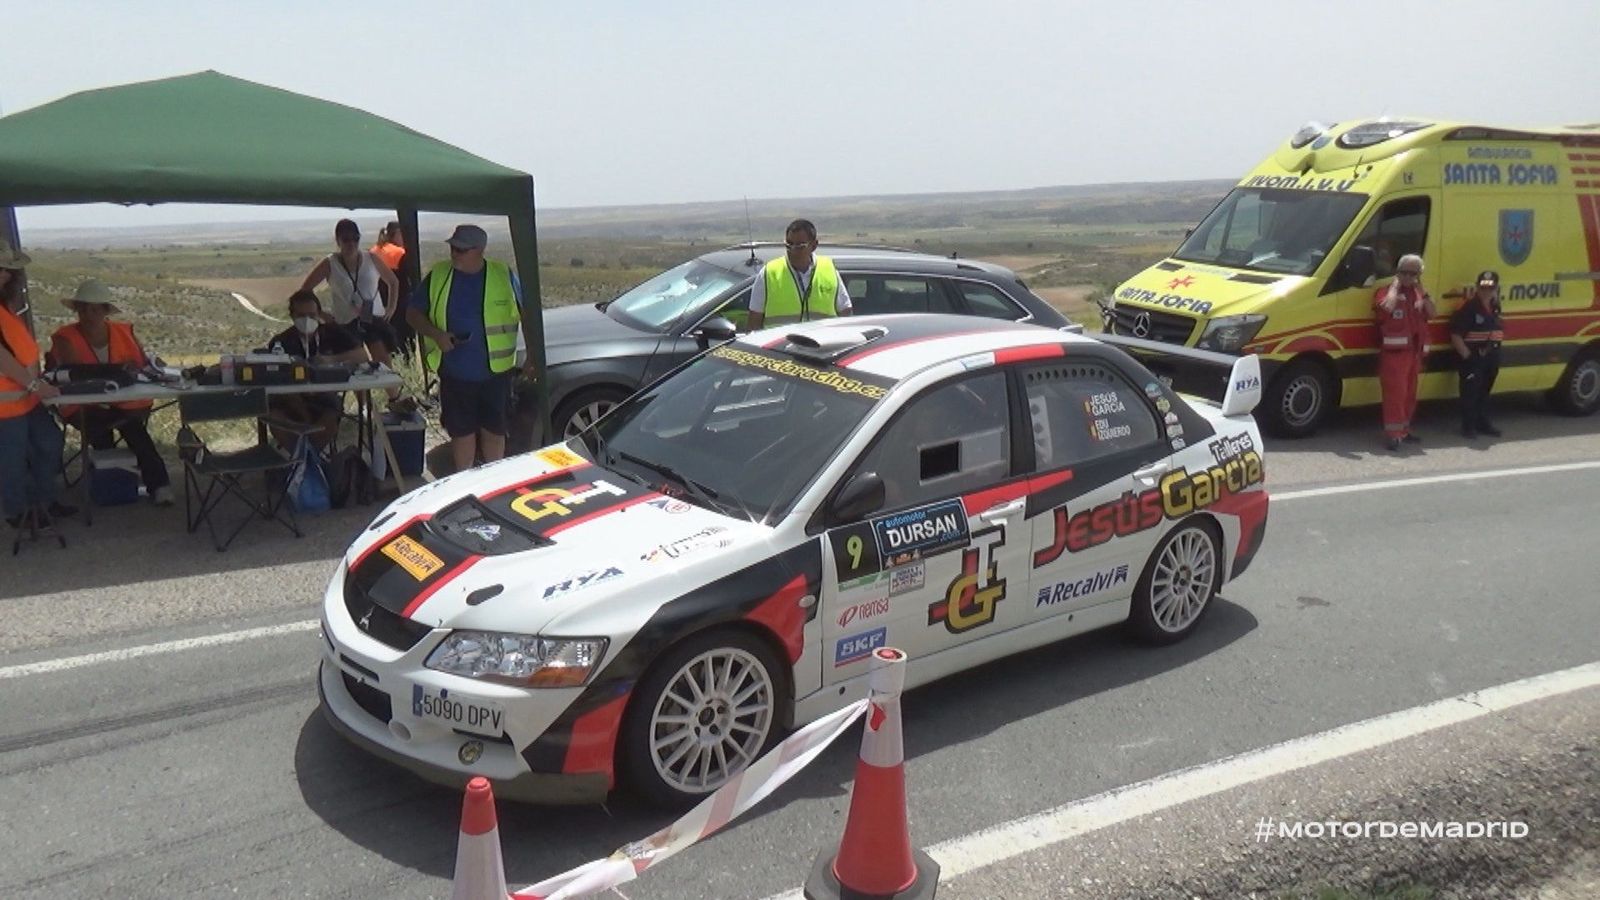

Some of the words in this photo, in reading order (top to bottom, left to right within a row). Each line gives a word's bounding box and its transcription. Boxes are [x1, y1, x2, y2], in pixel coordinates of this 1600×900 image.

[1444, 163, 1501, 185] SANTA
[1507, 164, 1558, 185] SOFIA
[1154, 293, 1214, 315] SOFIA
[1211, 434, 1252, 461] Talleres
[885, 511, 927, 528] automotor
[886, 513, 957, 548] DURSAN
[846, 535, 863, 569] 9
[1050, 567, 1115, 605] Recalvi
[840, 632, 883, 657] SKF
[423, 695, 463, 722] 5090
[468, 705, 501, 730] DPV
